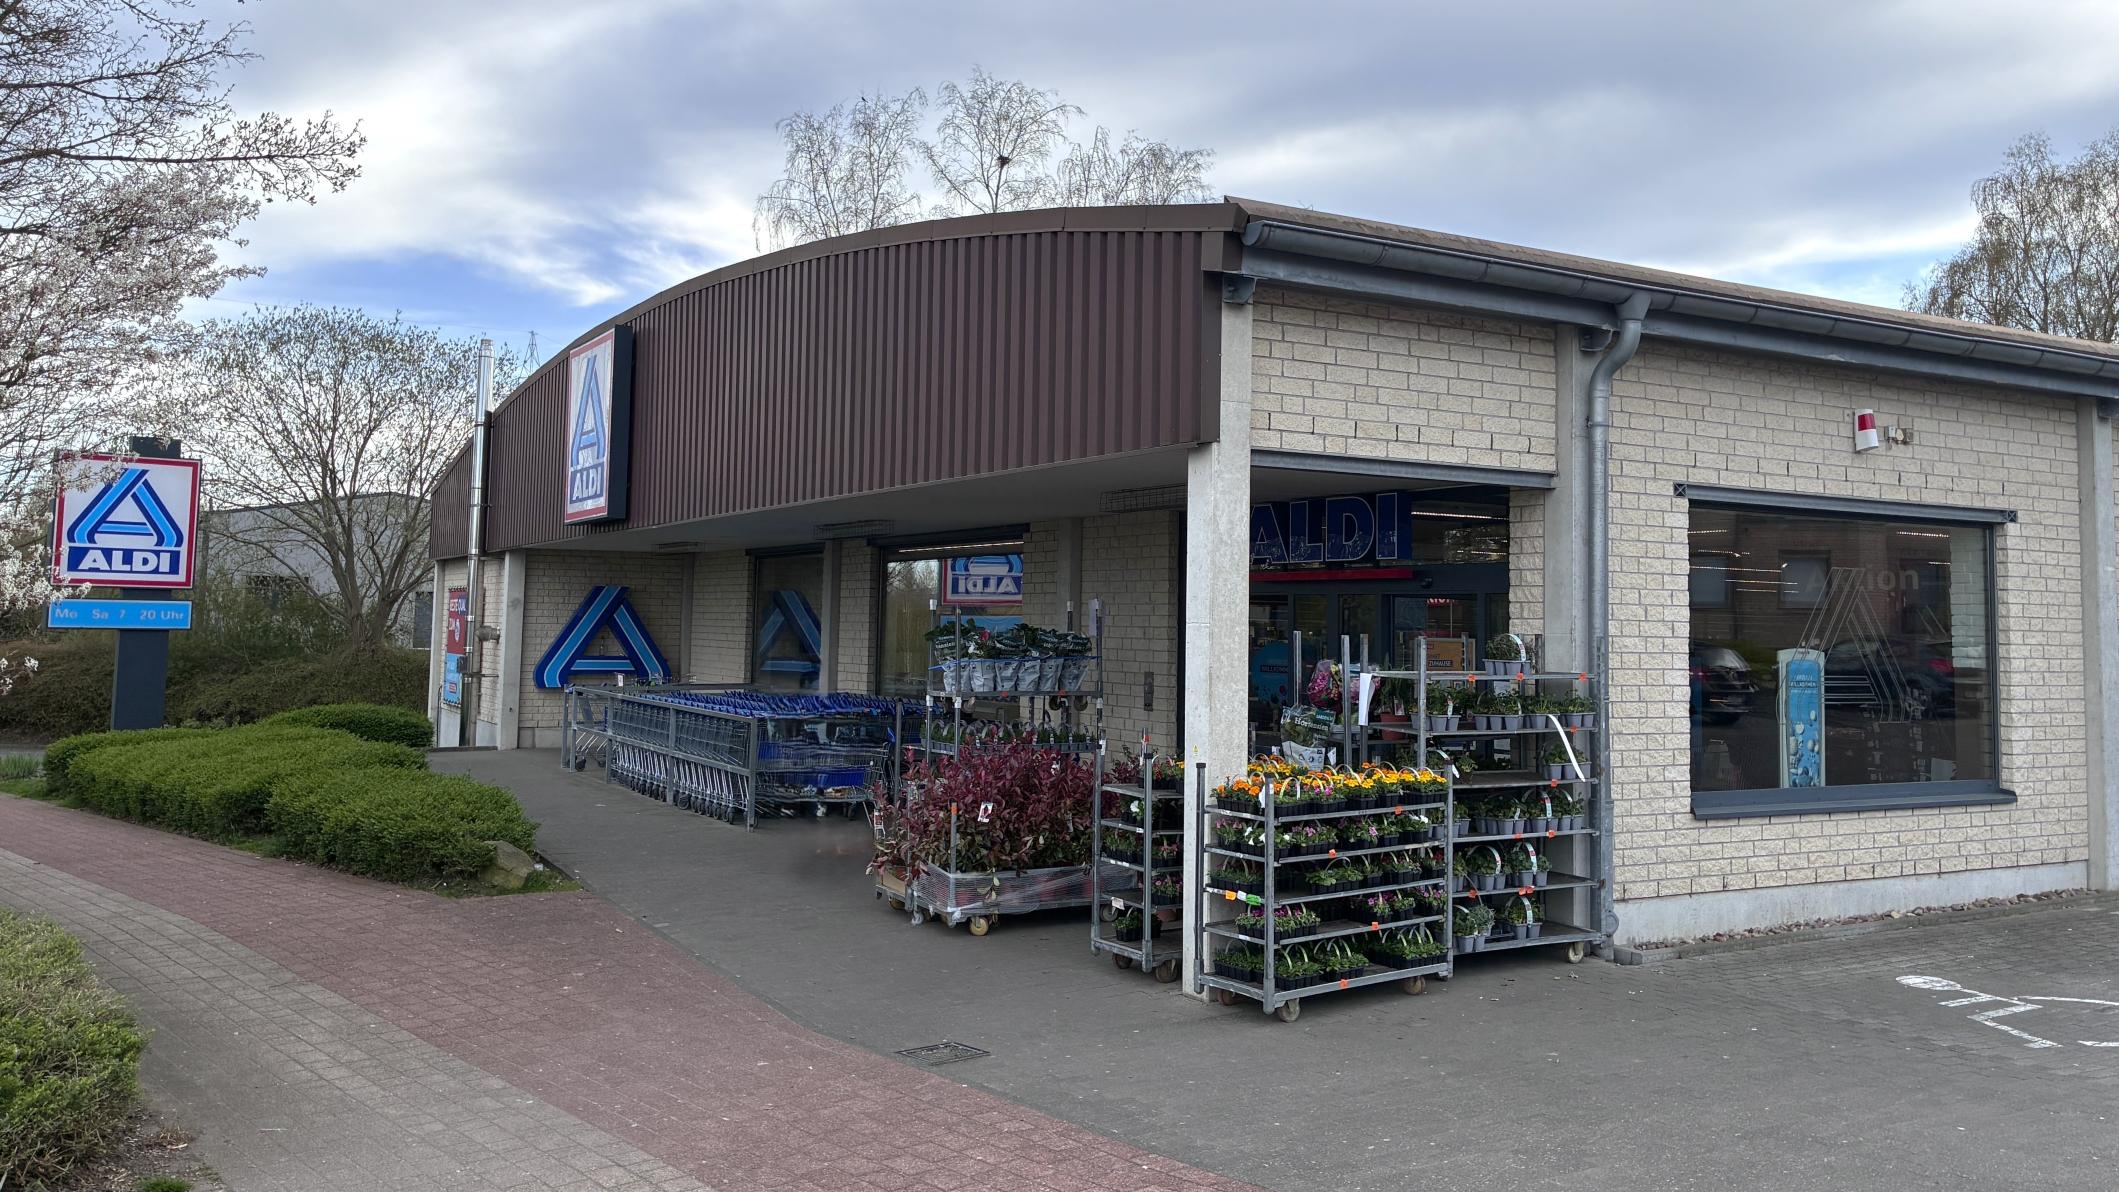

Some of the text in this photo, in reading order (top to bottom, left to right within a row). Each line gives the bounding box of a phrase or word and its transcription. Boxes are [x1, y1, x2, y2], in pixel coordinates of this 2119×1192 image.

[573, 466, 603, 501] ALDI
[1250, 493, 1398, 564] ALDI
[77, 549, 171, 573] ALDI
[55, 608, 78, 619] Mo
[92, 609, 109, 619] Sa
[139, 610, 156, 620] 20
[160, 610, 184, 620] Uhr
